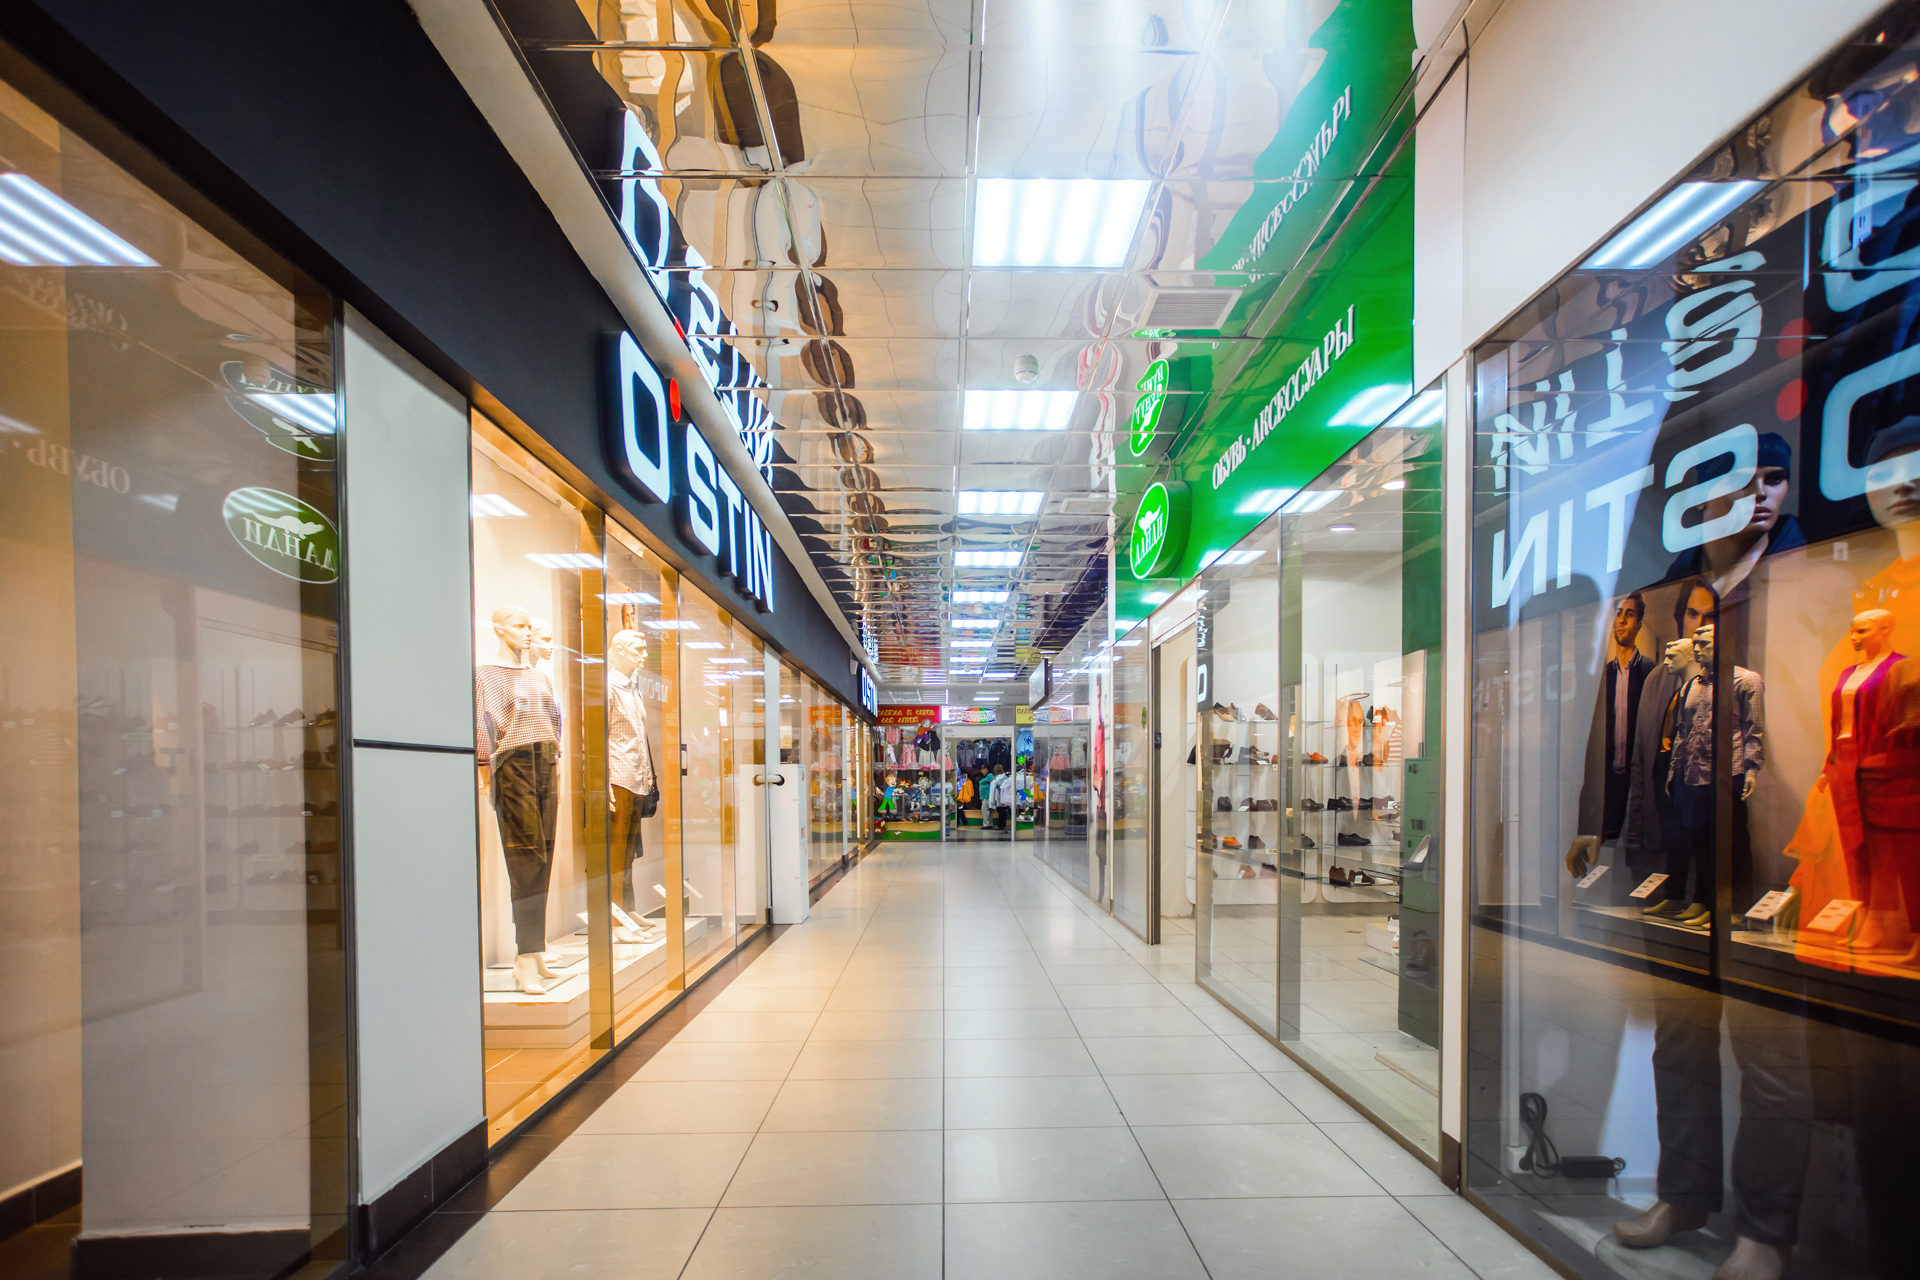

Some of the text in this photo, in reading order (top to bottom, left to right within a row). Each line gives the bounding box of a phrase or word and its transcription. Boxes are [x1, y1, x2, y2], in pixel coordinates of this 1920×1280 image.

[1212, 434, 1248, 490] ОБУВЬ
[1251, 303, 1355, 452] АКСЕССУАРЫ
[1134, 512, 1164, 570] ДАНДИ
